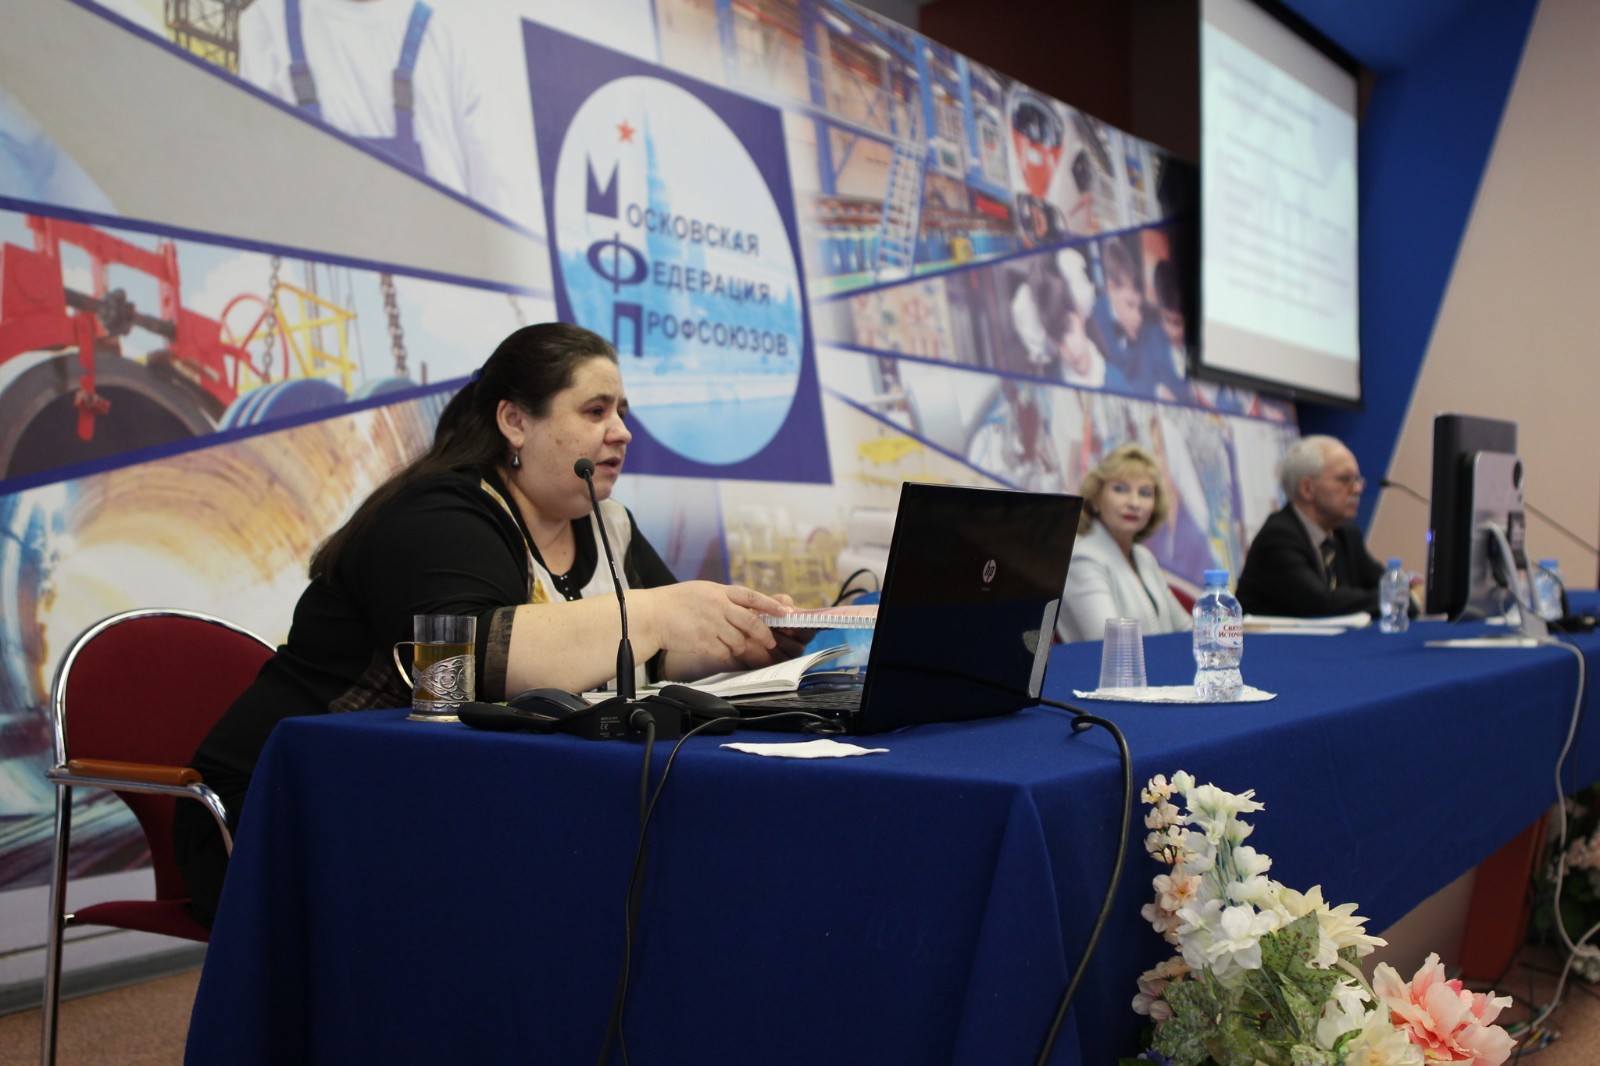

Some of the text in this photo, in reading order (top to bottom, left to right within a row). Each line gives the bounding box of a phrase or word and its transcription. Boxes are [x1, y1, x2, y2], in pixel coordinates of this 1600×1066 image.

[586, 151, 759, 257] МОСКОВСКАЯ
[586, 233, 771, 307] ФЕДЕРАЦИЯ
[613, 302, 789, 358] ПРОФСОЮЗОВ
